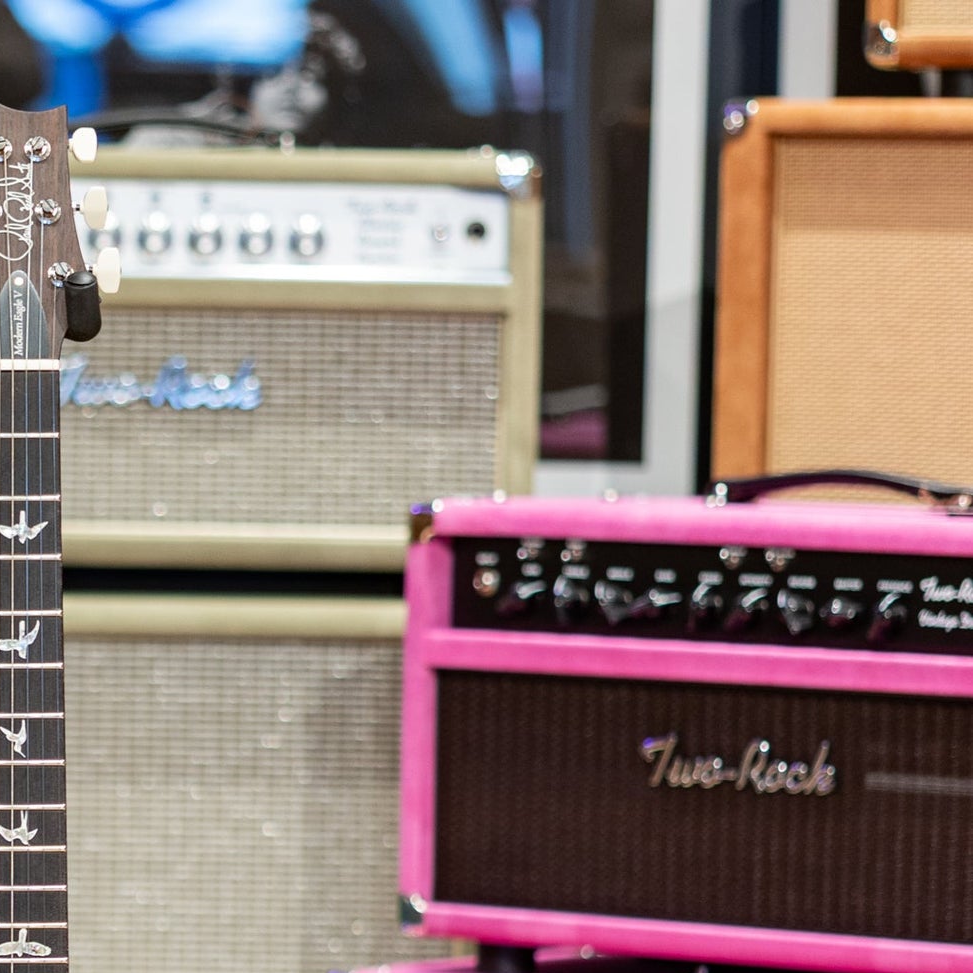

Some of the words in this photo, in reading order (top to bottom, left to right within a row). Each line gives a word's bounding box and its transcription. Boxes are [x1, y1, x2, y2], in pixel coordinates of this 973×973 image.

[13, 290, 23, 299] V
[13, 299, 26, 321] Eagle
[13, 322, 24, 356] Modern
[641, 735, 836, 796] Two-Rock
